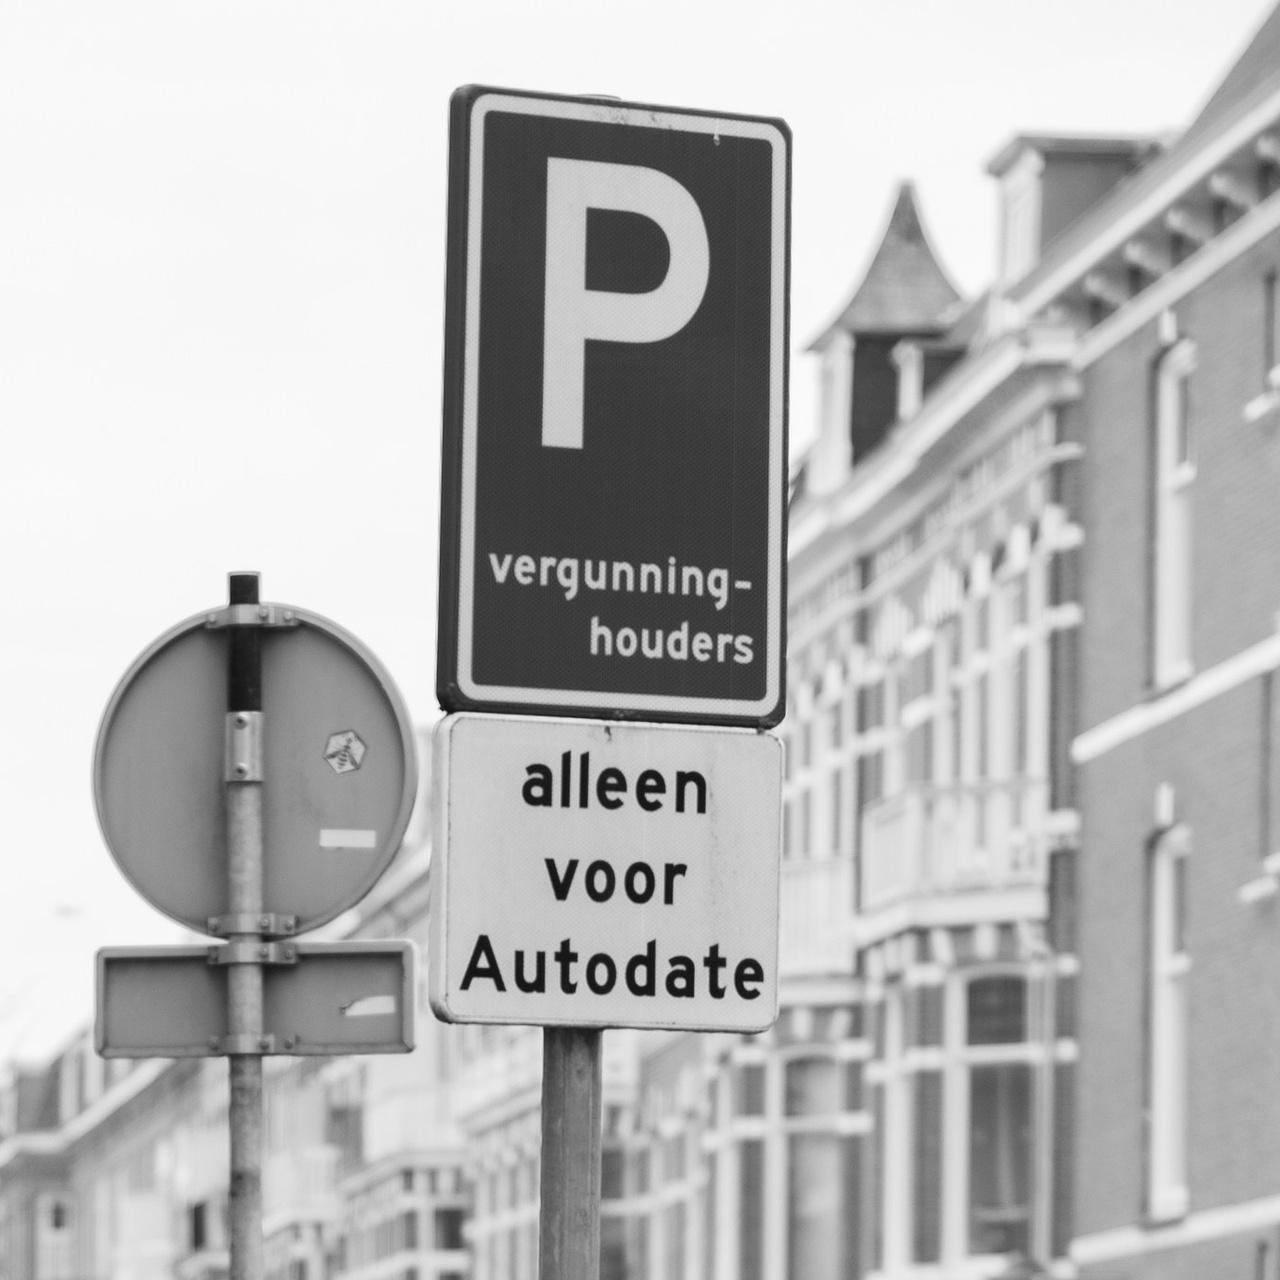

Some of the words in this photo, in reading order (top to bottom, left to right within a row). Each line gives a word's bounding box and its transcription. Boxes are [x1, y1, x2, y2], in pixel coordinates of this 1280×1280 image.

[541, 156, 710, 449] P
[488, 552, 752, 609] vergunning-
[589, 616, 754, 664] houders
[521, 750, 707, 814] alleen
[544, 857, 688, 905] voor
[459, 934, 764, 1000] Autodate
